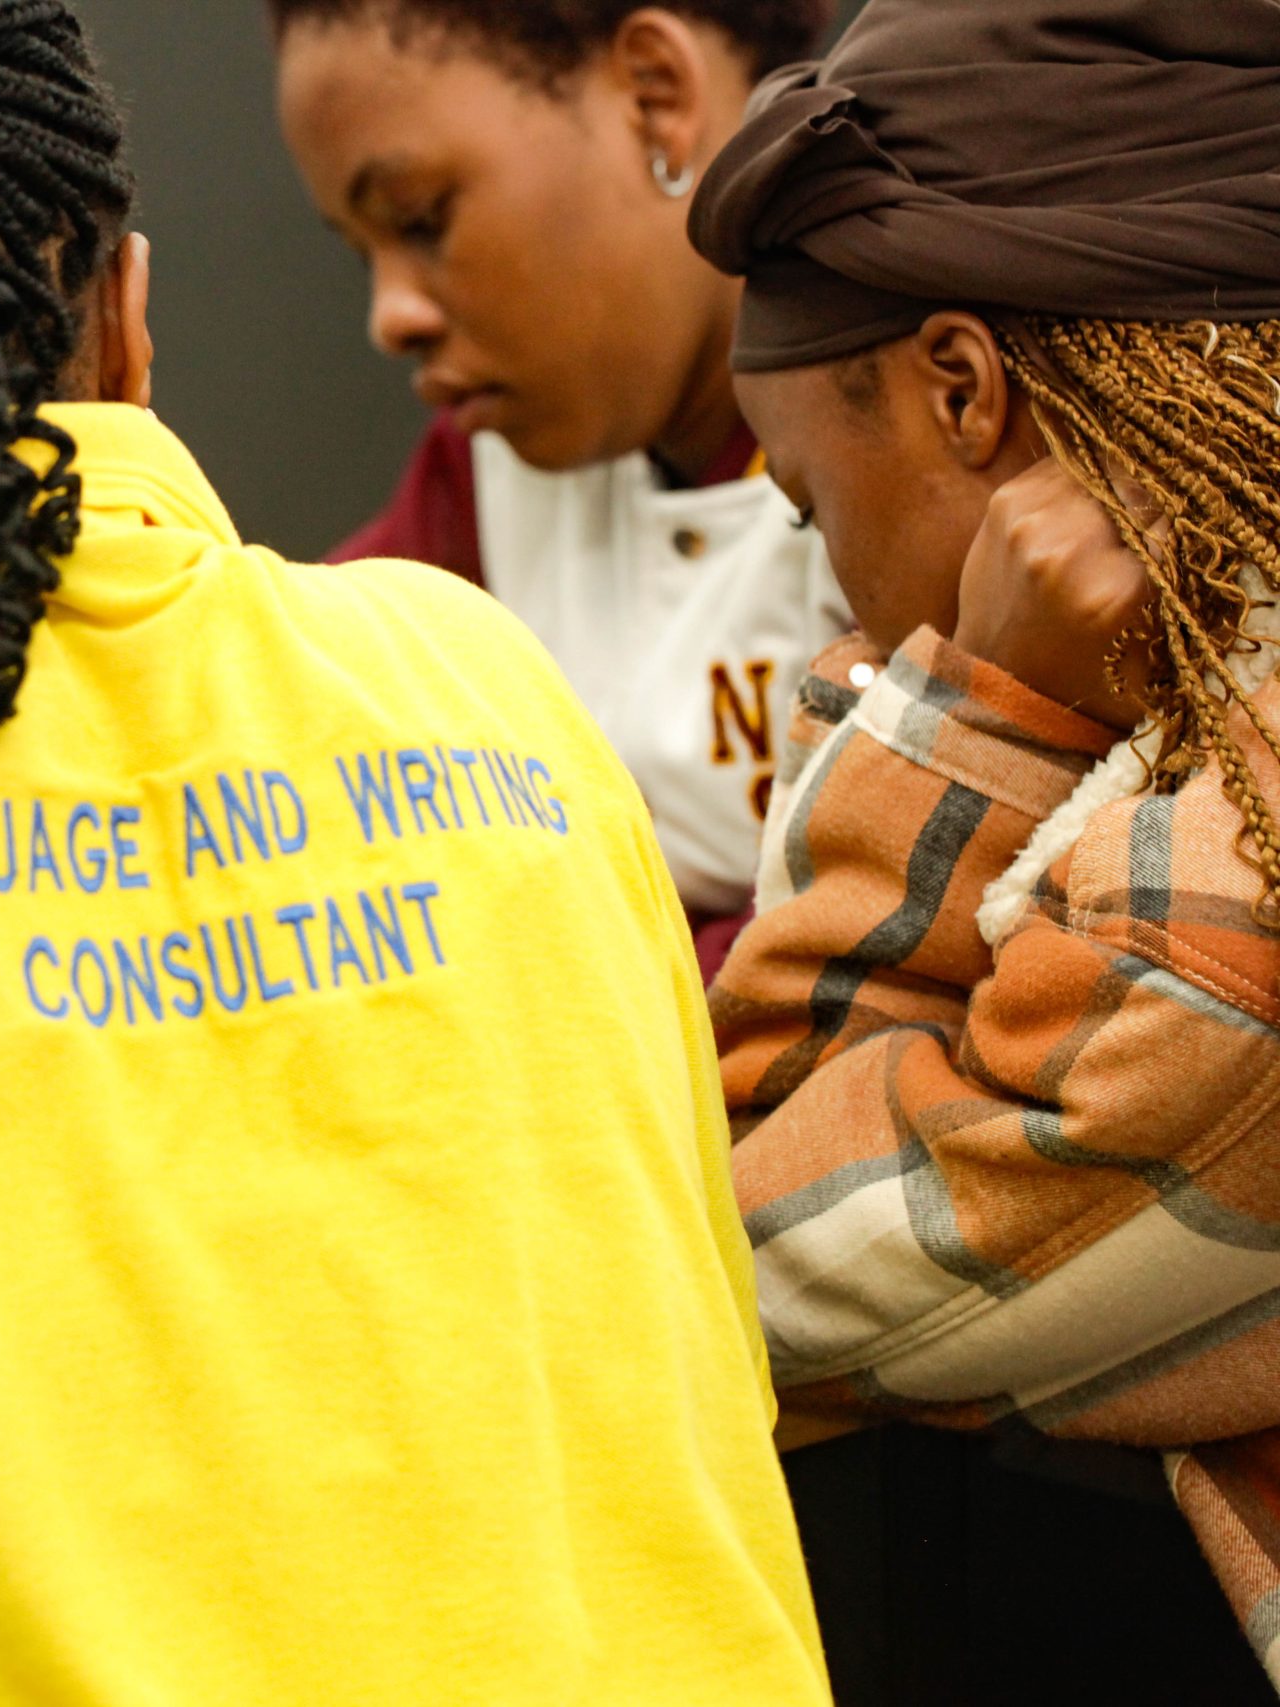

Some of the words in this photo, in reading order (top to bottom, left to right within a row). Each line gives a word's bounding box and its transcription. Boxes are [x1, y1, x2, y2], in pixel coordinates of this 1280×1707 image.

[183, 768, 308, 878] AND
[334, 744, 569, 844] WRITING
[22, 881, 446, 1029] CONSULTANT
